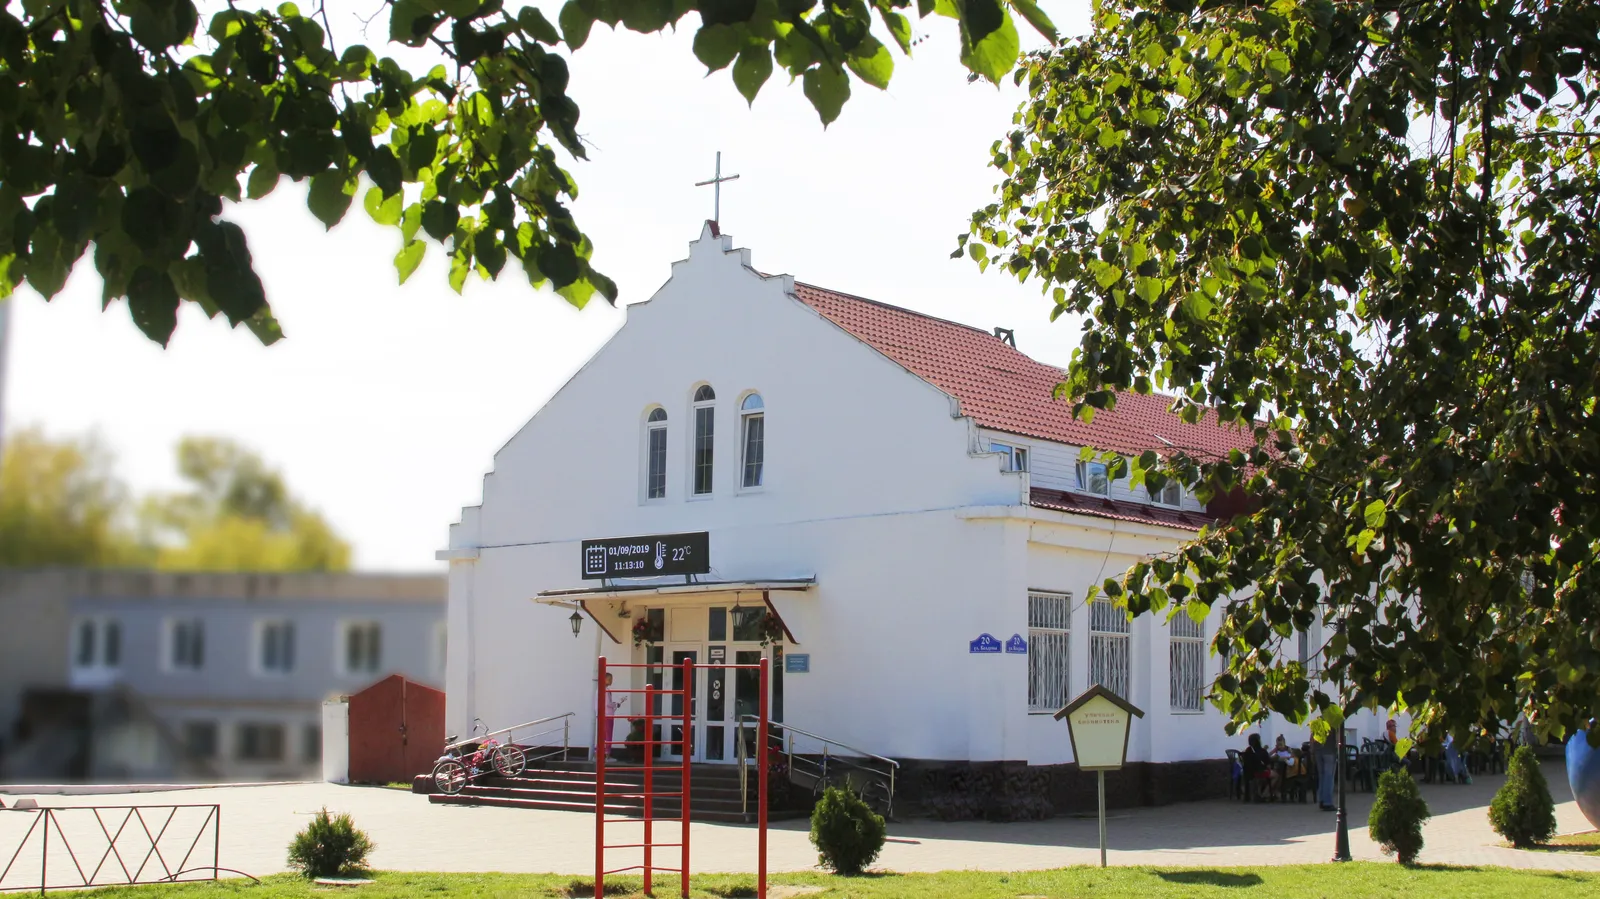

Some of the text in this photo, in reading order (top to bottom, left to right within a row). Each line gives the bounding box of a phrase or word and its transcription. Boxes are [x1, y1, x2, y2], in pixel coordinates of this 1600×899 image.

[608, 545, 650, 556] 01/09/2019
[614, 560, 644, 570] 11:13:10
[981, 636, 991, 645] 20
[1013, 636, 1021, 645] 20
